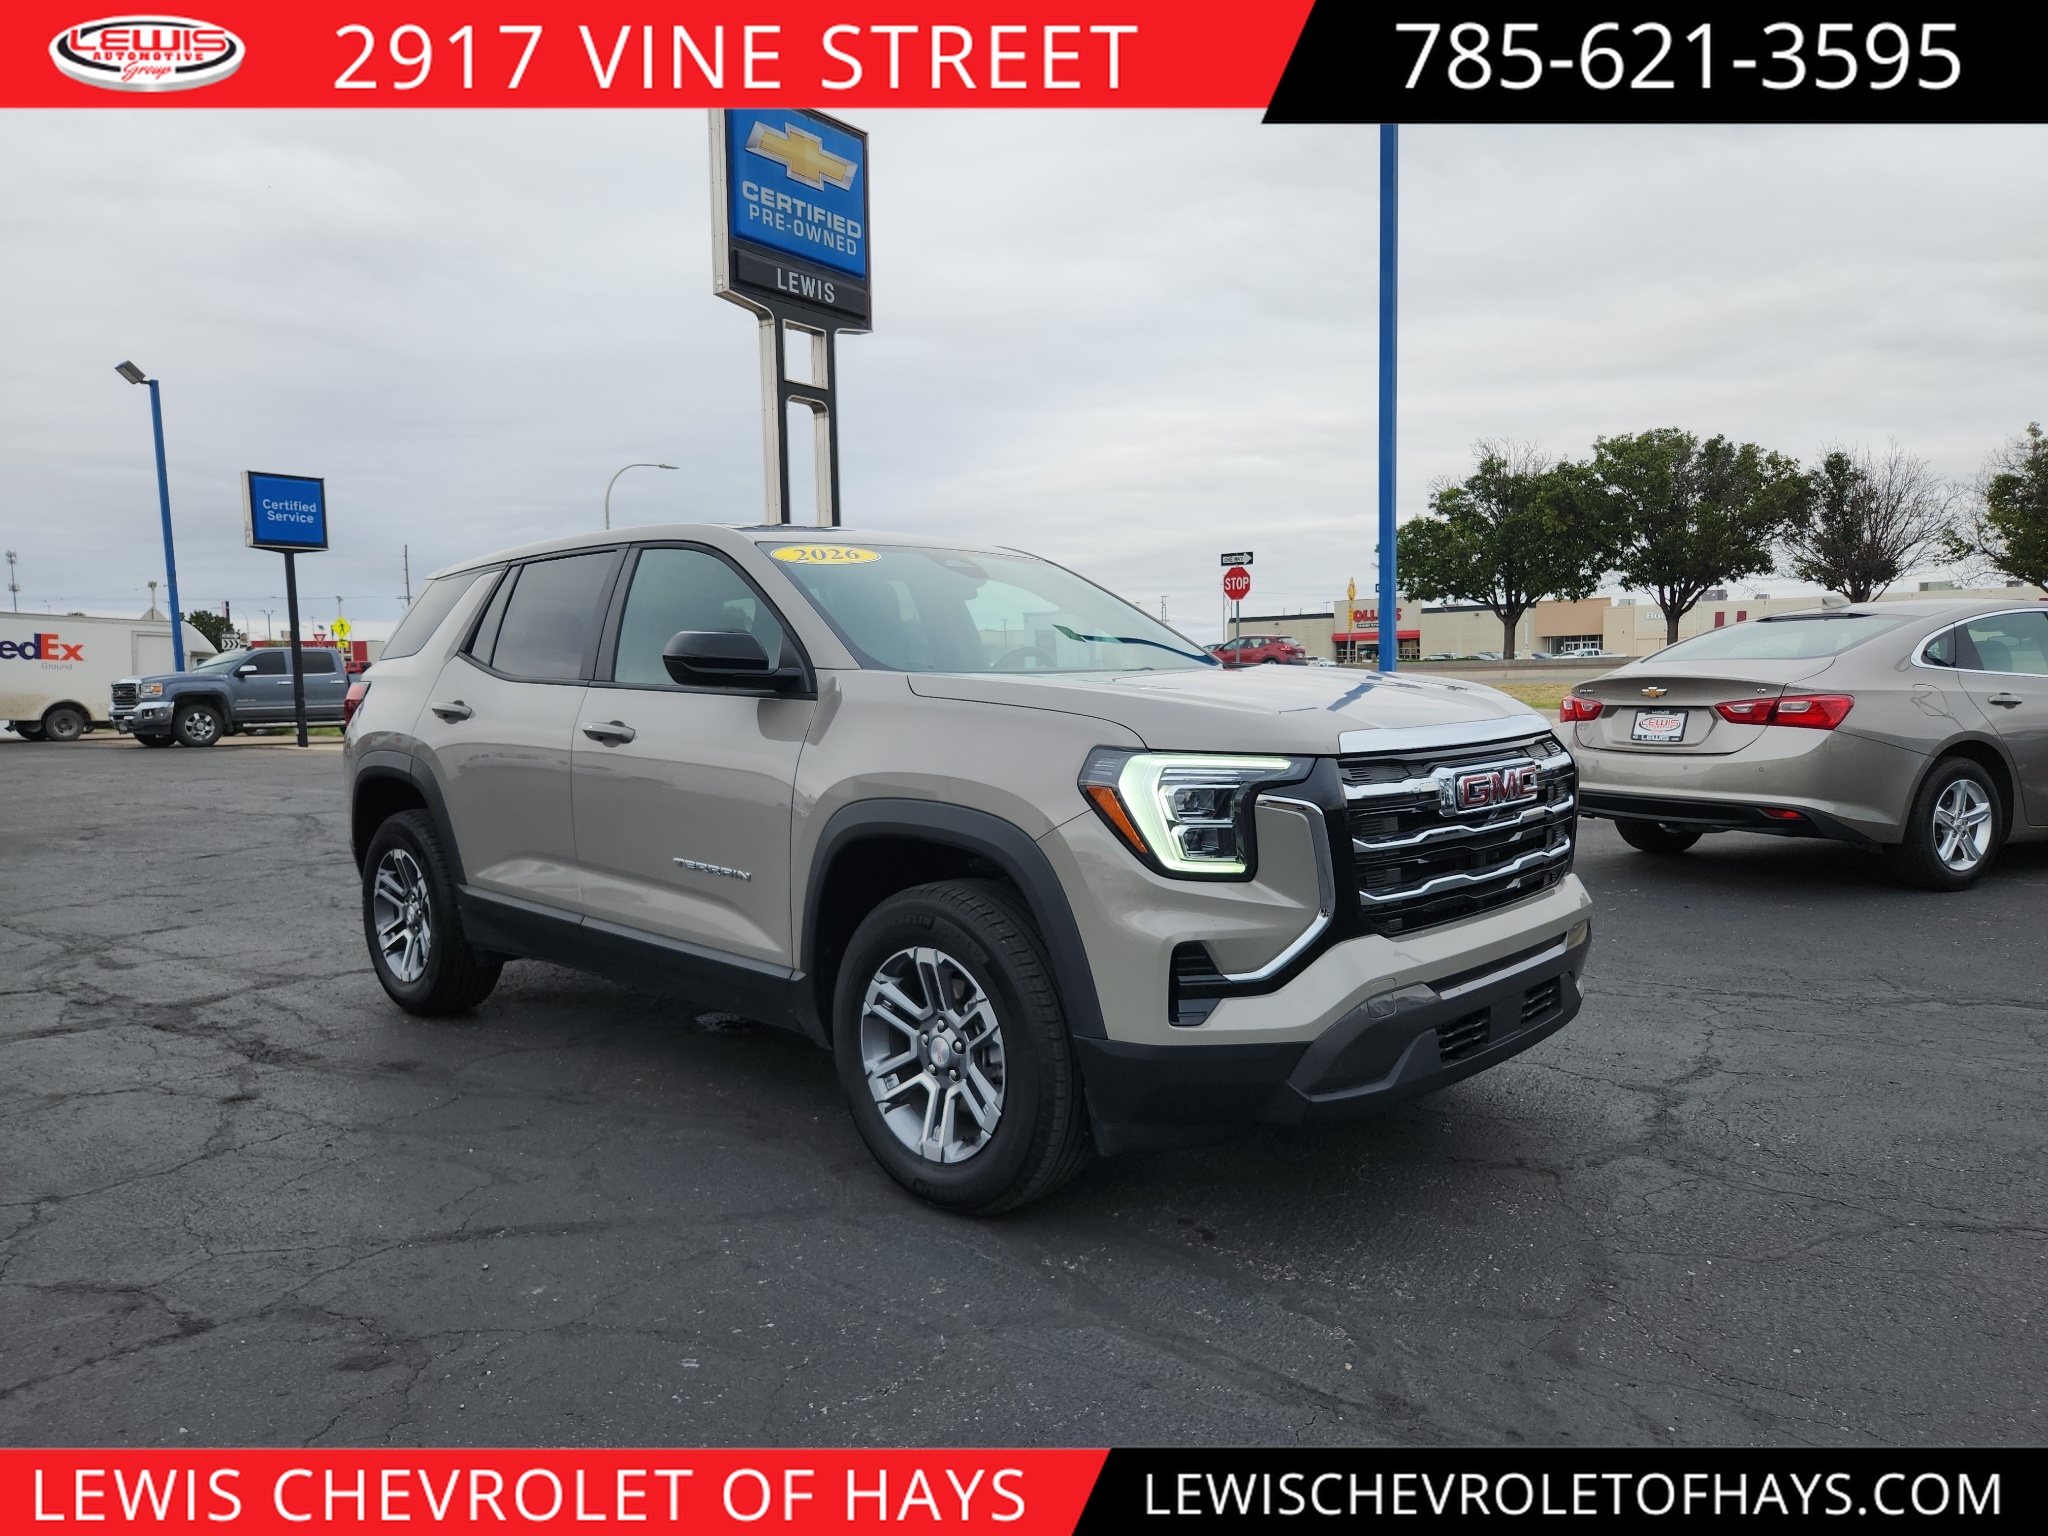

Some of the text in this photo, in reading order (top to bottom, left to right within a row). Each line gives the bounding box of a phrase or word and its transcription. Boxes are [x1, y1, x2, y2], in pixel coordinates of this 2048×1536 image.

[742, 180, 861, 239] CERTIFIED
[749, 203, 857, 256] PRE-OWNED
[777, 267, 835, 303] LEWIS
[262, 498, 317, 513] Certified
[267, 510, 315, 523] Service
[793, 548, 861, 561] 2026
[1224, 576, 1250, 590] STOP
[1353, 608, 1402, 623] OLLS
[0, 633, 84, 661] edEx
[41, 662, 73, 670] Ground
[1457, 765, 1538, 808] GMC
[673, 857, 752, 881] TERRAIN
